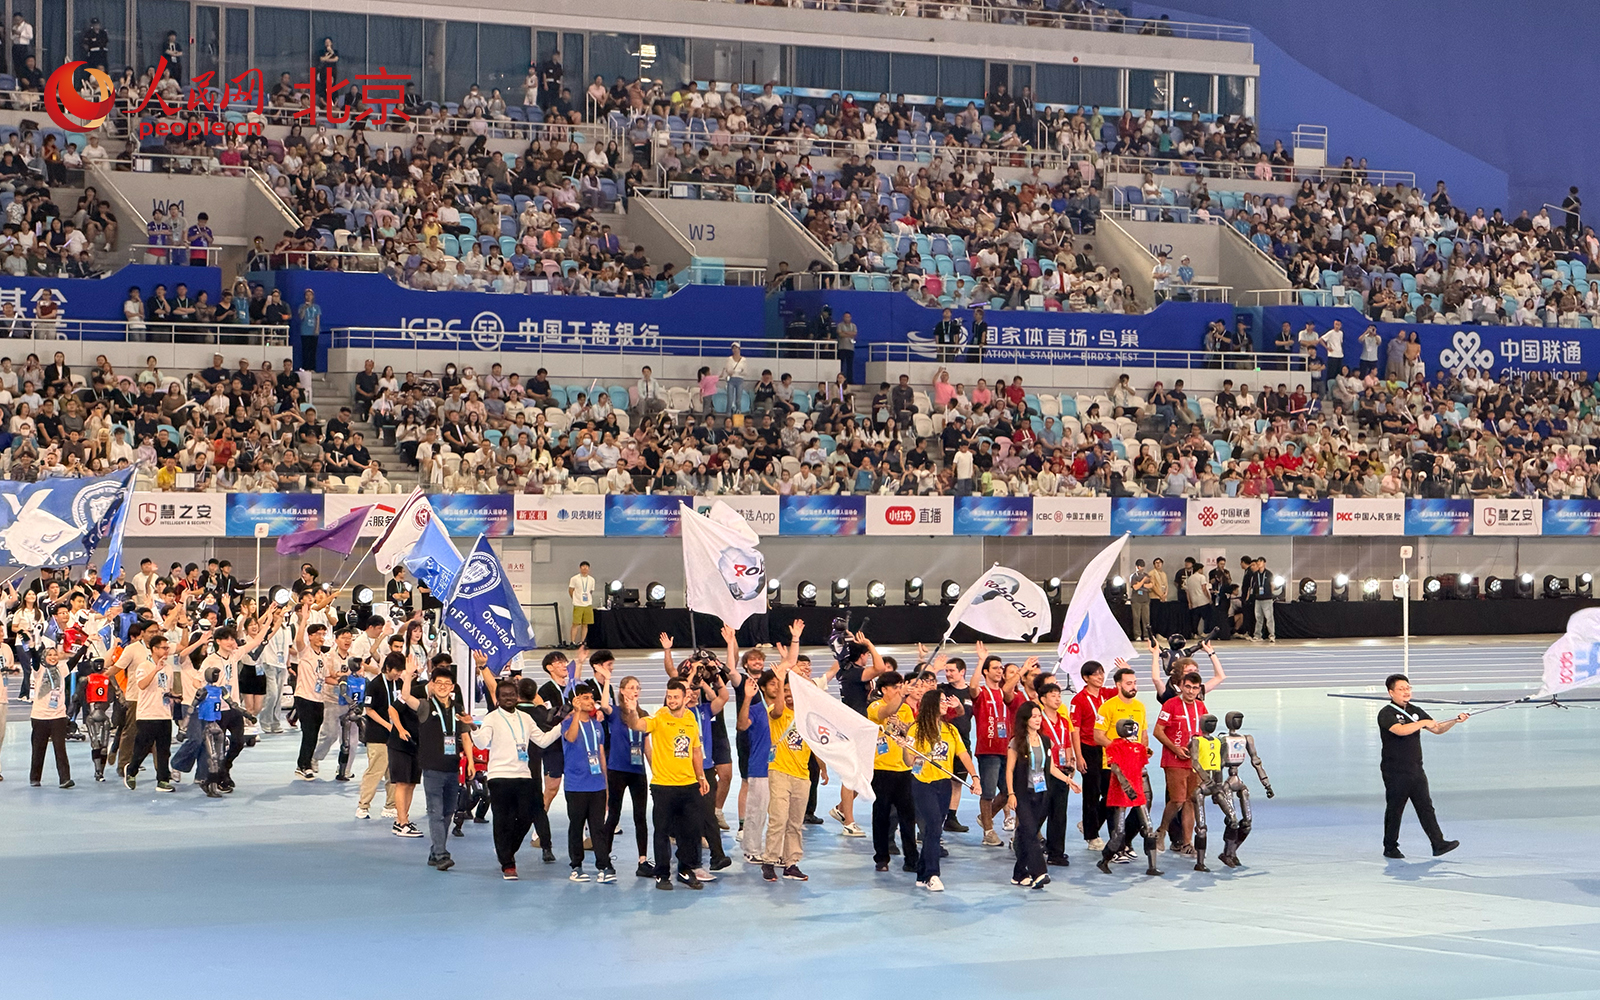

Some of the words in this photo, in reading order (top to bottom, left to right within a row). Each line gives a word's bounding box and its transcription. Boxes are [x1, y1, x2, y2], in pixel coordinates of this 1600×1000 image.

[689, 223, 716, 241] W3
[401, 317, 462, 341] ICBC
[518, 317, 660, 348] 中国工商银行
[984, 350, 1026, 360] ATIONAL
[1115, 353, 1139, 362] NEST
[1500, 338, 1582, 364] 中国联通
[1501, 366, 1532, 381] Chin
[160, 505, 212, 519] 慧之安
[518, 510, 547, 520] 新京报
[571, 510, 602, 520] 贝壳财经
[889, 510, 912, 522] 小红书
[919, 507, 942, 524] 直播
[1036, 513, 1052, 521] ICBC
[1065, 512, 1104, 521] 中国工商银行
[1220, 508, 1250, 518] 中国联通
[1336, 512, 1353, 521] PICC
[1354, 512, 1402, 521] 中国人民保险
[1498, 509, 1533, 521] 慧之安
[97, 688, 103, 696] 6
[353, 692, 359, 701] 2
[1209, 752, 1217, 766] 2
